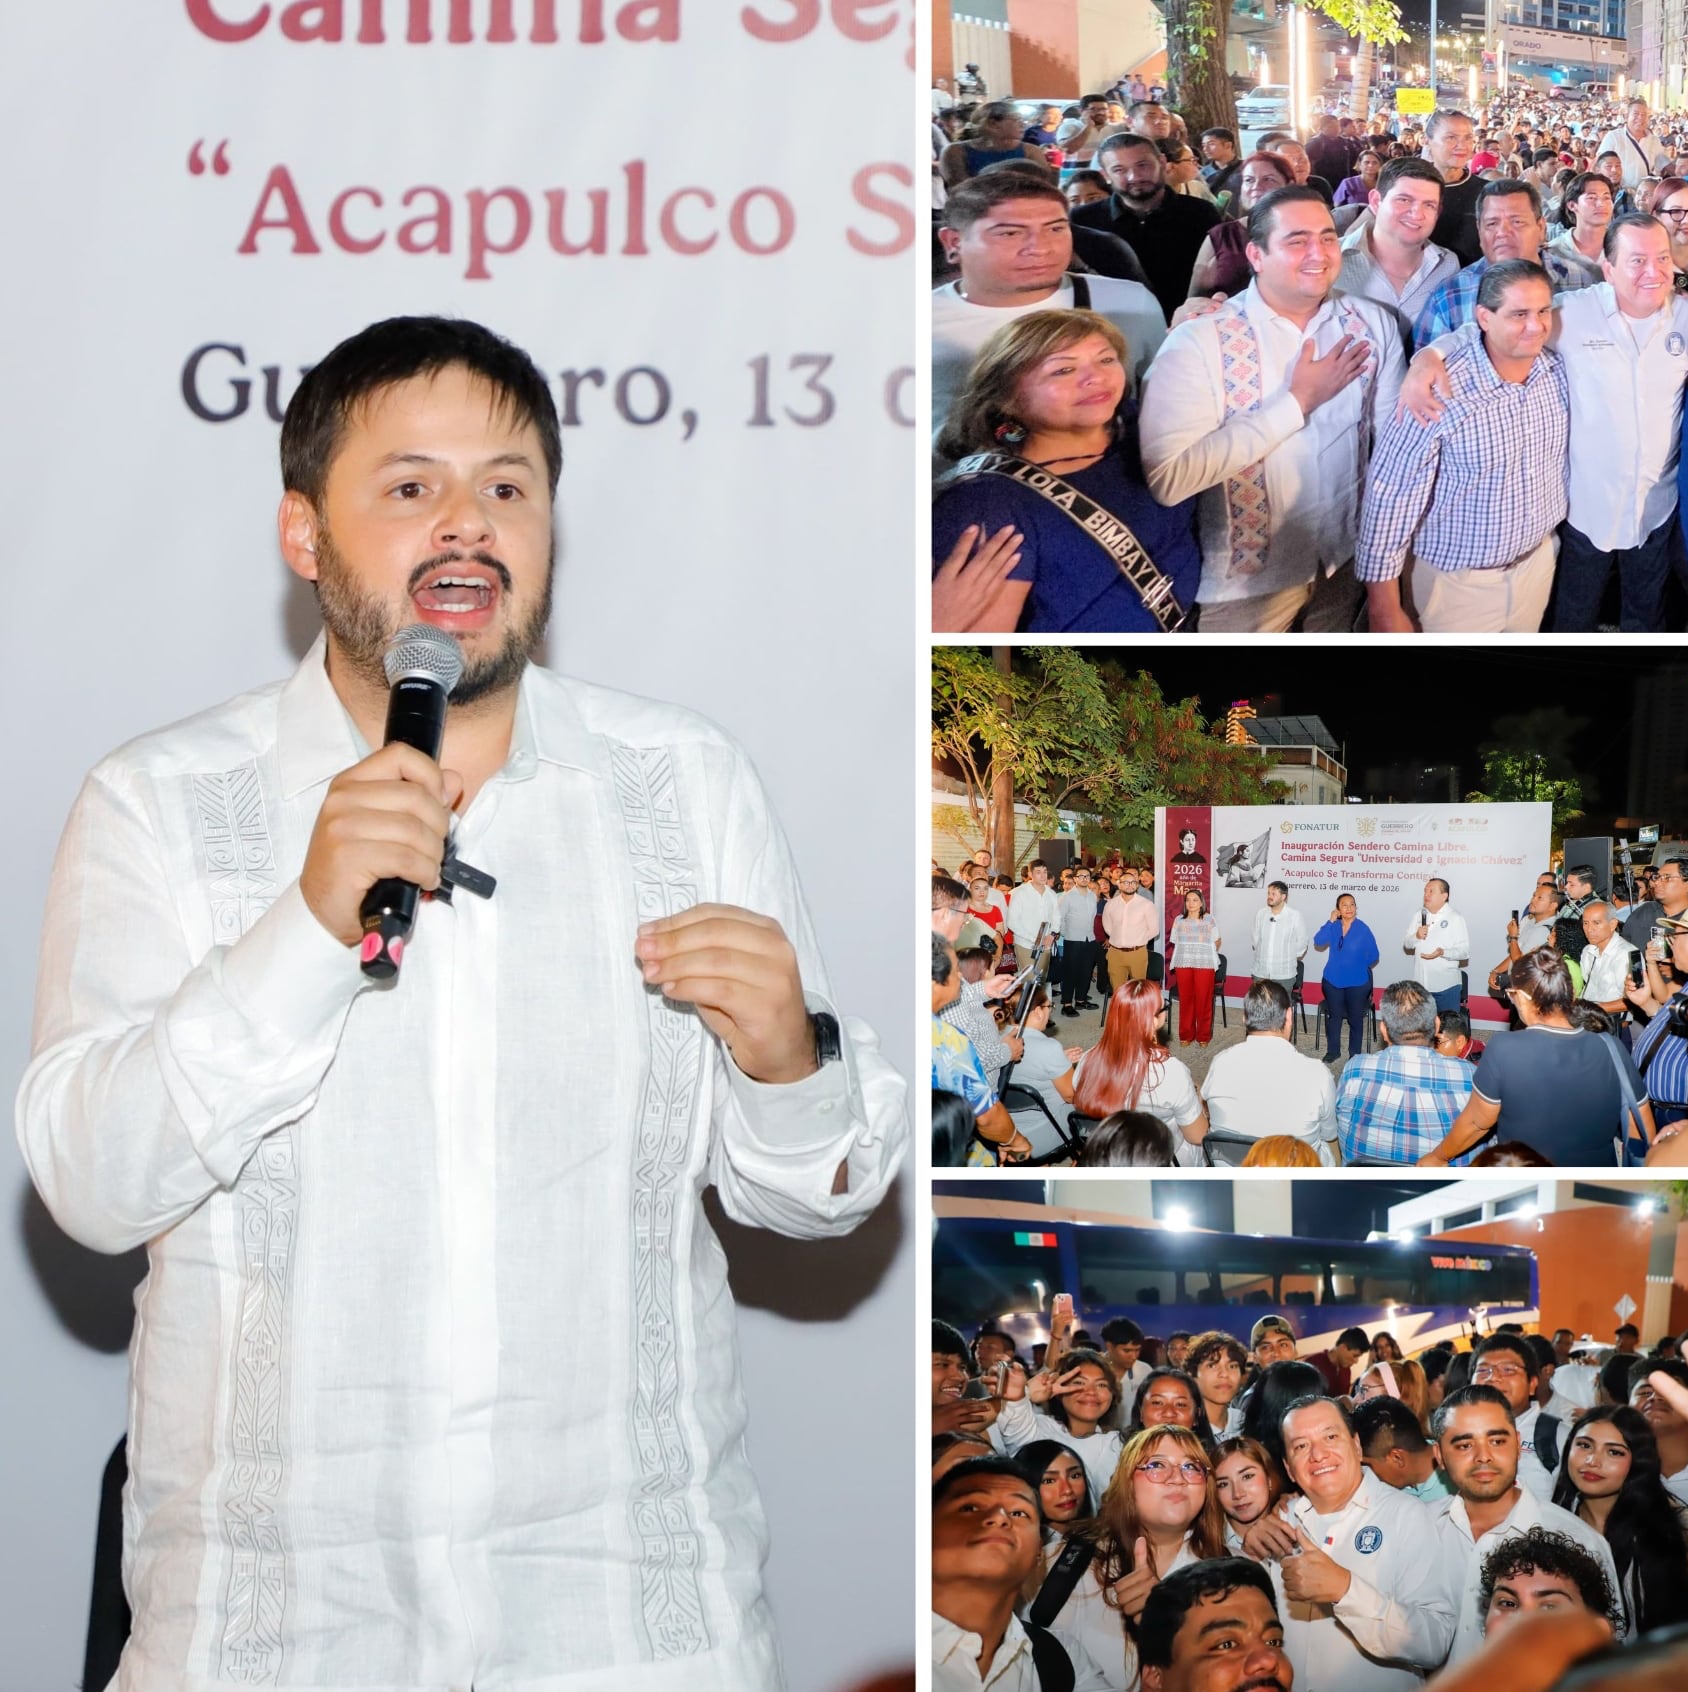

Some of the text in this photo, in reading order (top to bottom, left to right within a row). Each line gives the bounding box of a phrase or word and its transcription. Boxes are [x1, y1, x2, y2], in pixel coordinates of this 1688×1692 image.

[741, 0, 916, 72] Se
[187, 138, 798, 282] “Acapulco
[180, 343, 700, 441] Guro,
[745, 353, 838, 428] 13
[1015, 465, 1078, 510] LOLA
[1083, 509, 1153, 581] BIMBAY
[1294, 823, 1340, 831] FONATUR
[1281, 841, 1345, 852] Inauguración
[1347, 841, 1390, 851] Sendero
[1394, 842, 1434, 852] Camina
[1281, 853, 1317, 862] Camina
[1320, 853, 1355, 864] Segura
[1437, 855, 1477, 866] Ignacio
[1174, 865, 1202, 874] 2026
[1326, 870, 1338, 878] Se
[1341, 870, 1394, 880] Transforma
[1173, 885, 1203, 895] Ma
[1368, 884, 1379, 892] de
